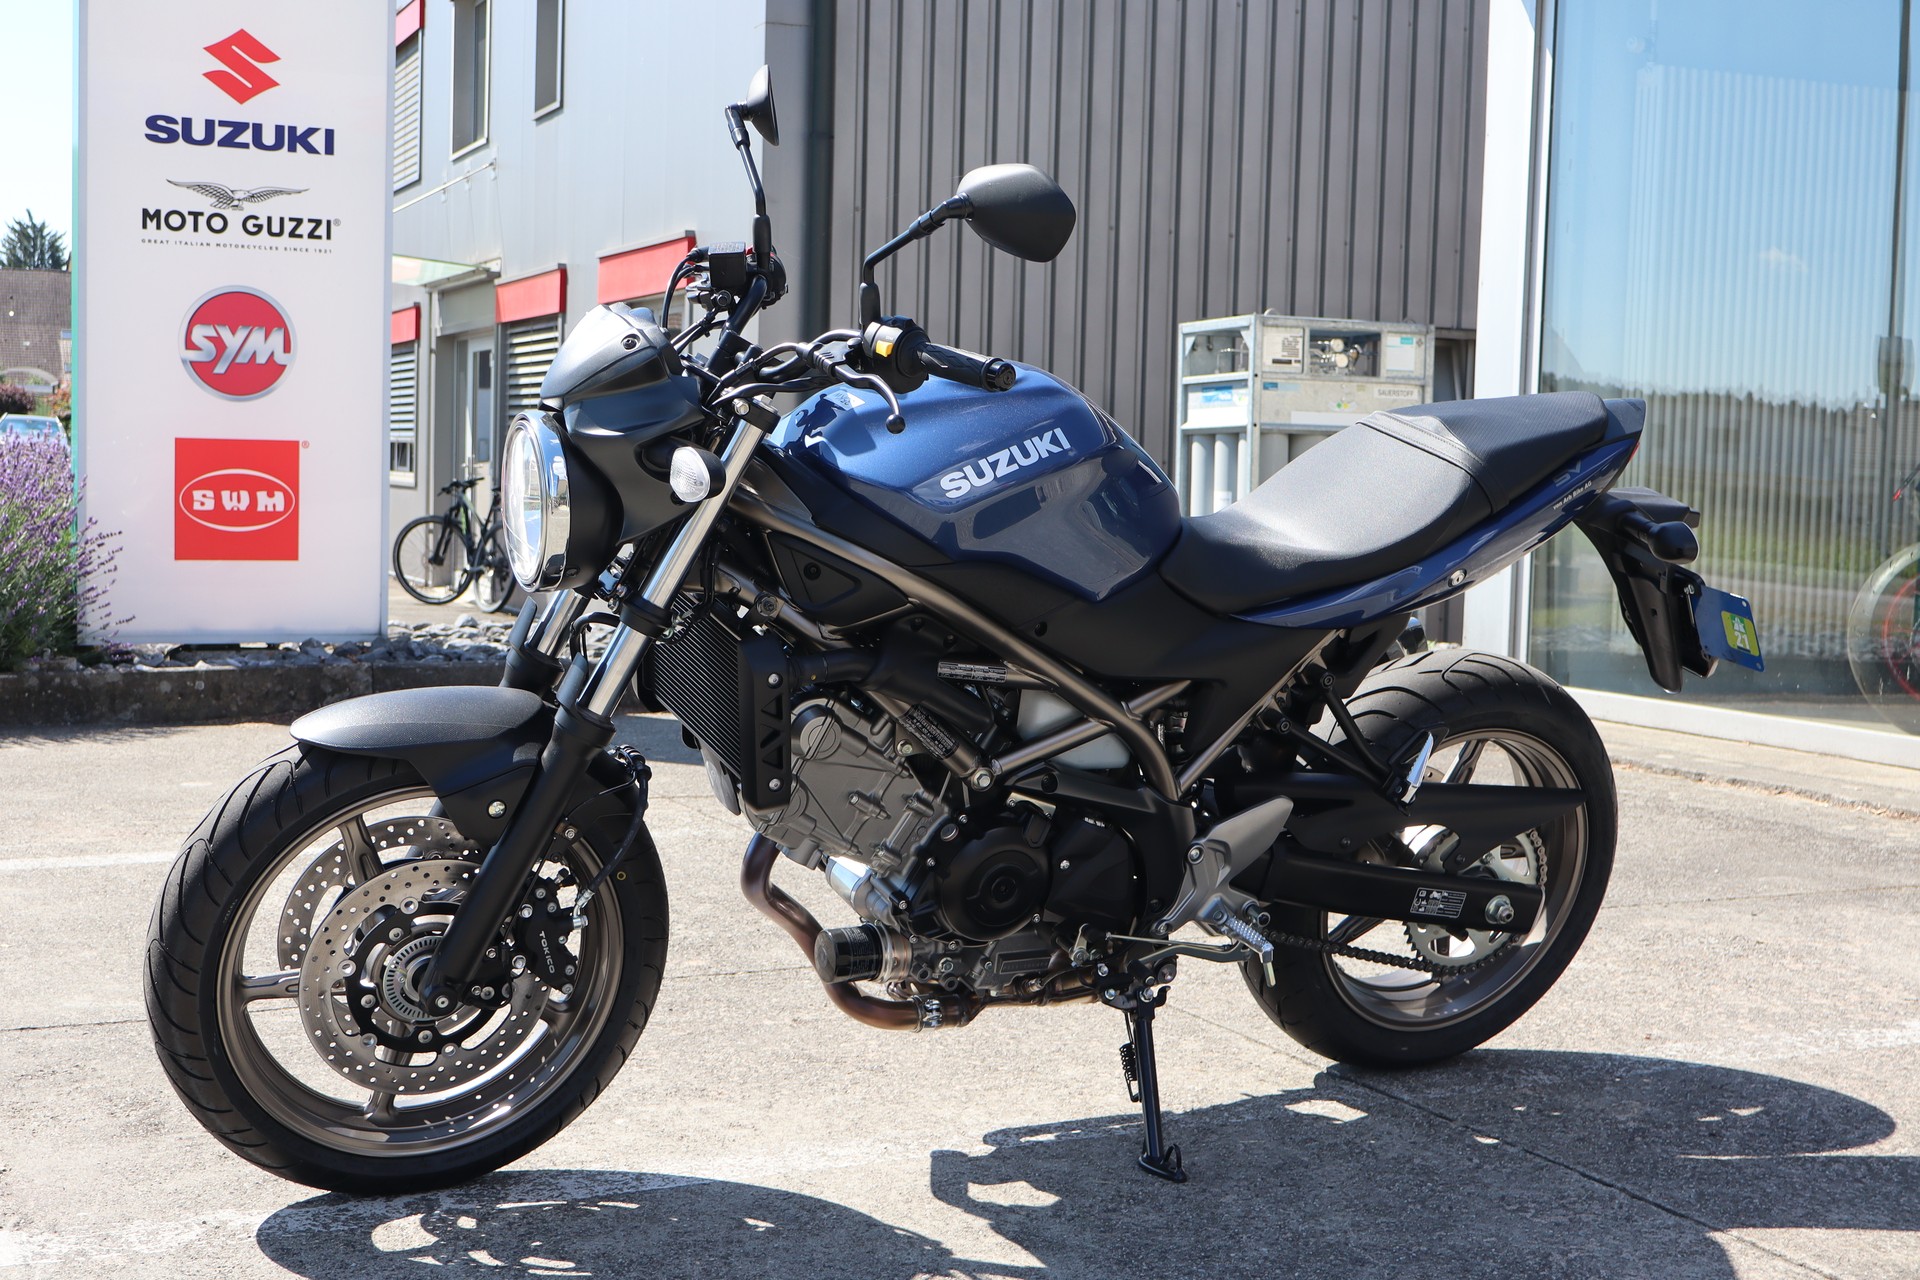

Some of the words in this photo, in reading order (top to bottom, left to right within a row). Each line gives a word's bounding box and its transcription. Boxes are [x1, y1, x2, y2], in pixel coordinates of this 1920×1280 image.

[144, 114, 335, 156] SUZUKI
[141, 208, 229, 234] MOTO
[242, 214, 332, 241] GUZZI
[215, 242, 279, 251] MOTORCYCLES
[182, 323, 293, 375] SYM
[1377, 388, 1415, 398] SAUERSTOFF
[939, 427, 1071, 499] SUZUKI
[1584, 480, 1592, 489] AG
[192, 489, 285, 513] SWM
[1734, 631, 1750, 650] 21
[539, 930, 555, 974] TOKICO
